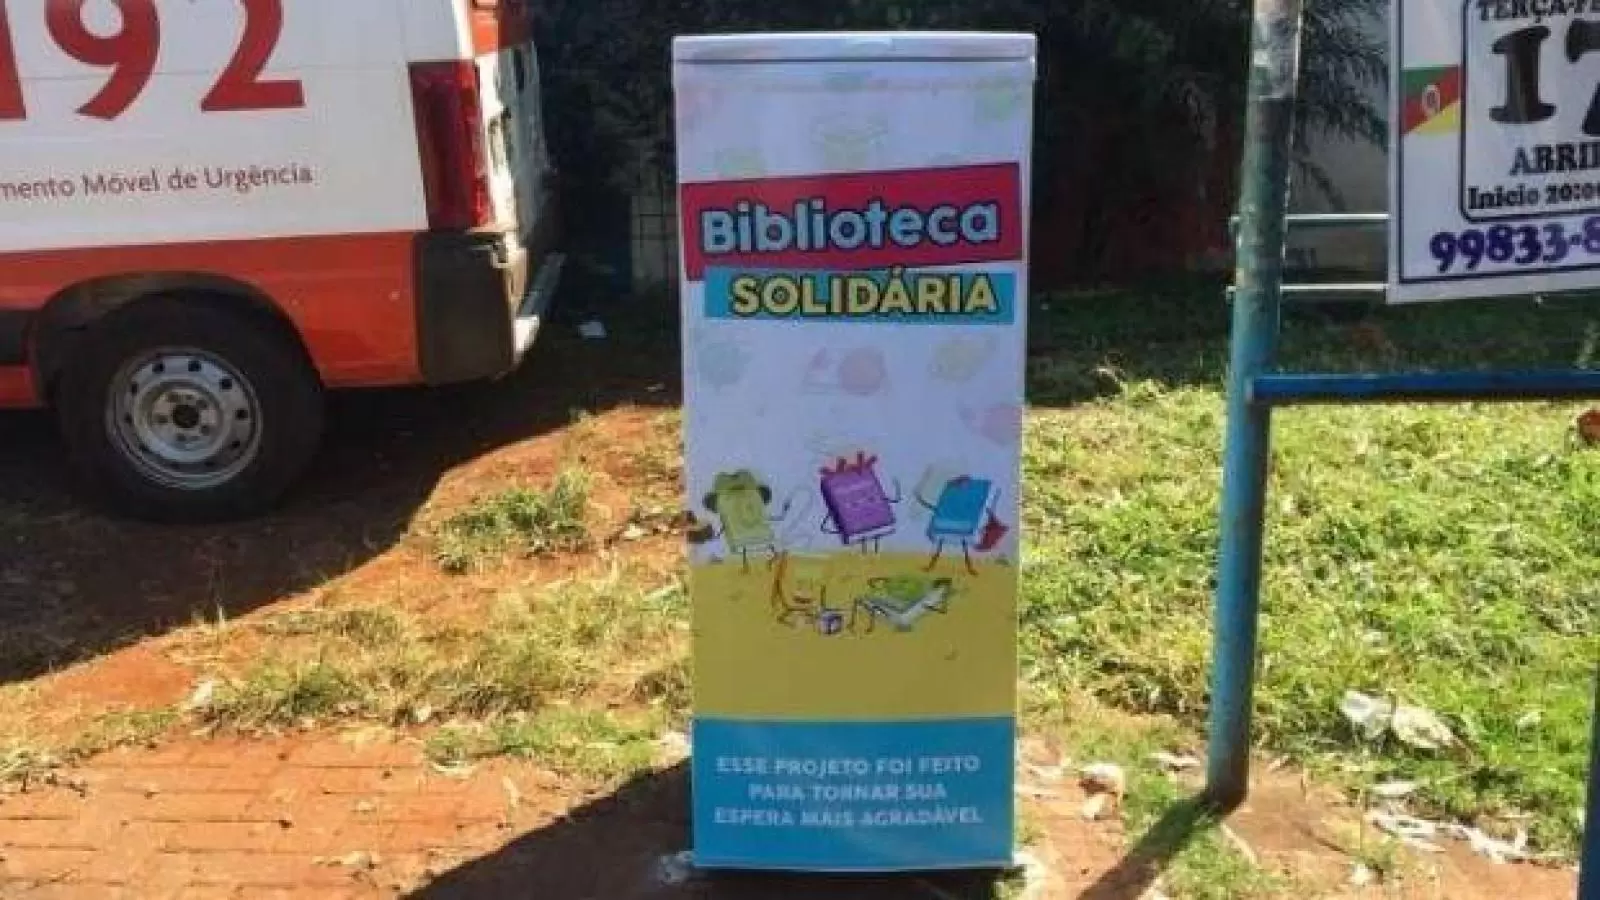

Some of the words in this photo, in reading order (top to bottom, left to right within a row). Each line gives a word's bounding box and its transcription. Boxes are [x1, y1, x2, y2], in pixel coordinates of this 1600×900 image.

[82, 167, 160, 194] Móvel
[167, 167, 197, 190] de
[204, 162, 313, 193] Urgência
[700, 196, 1000, 254] Biblioteca
[731, 266, 998, 316] SOLIDÁRIA
[716, 756, 769, 773] ESSE
[774, 757, 871, 779] PROJETO
[876, 757, 912, 775] FOI
[918, 754, 981, 774] FEITO
[748, 783, 802, 801] PARA
[811, 783, 899, 801] TORNAR
[904, 783, 947, 800] SUA
[714, 806, 794, 825] ESPERA
[799, 807, 853, 826] MAIS
[858, 803, 984, 826] AGRADÁVEL
